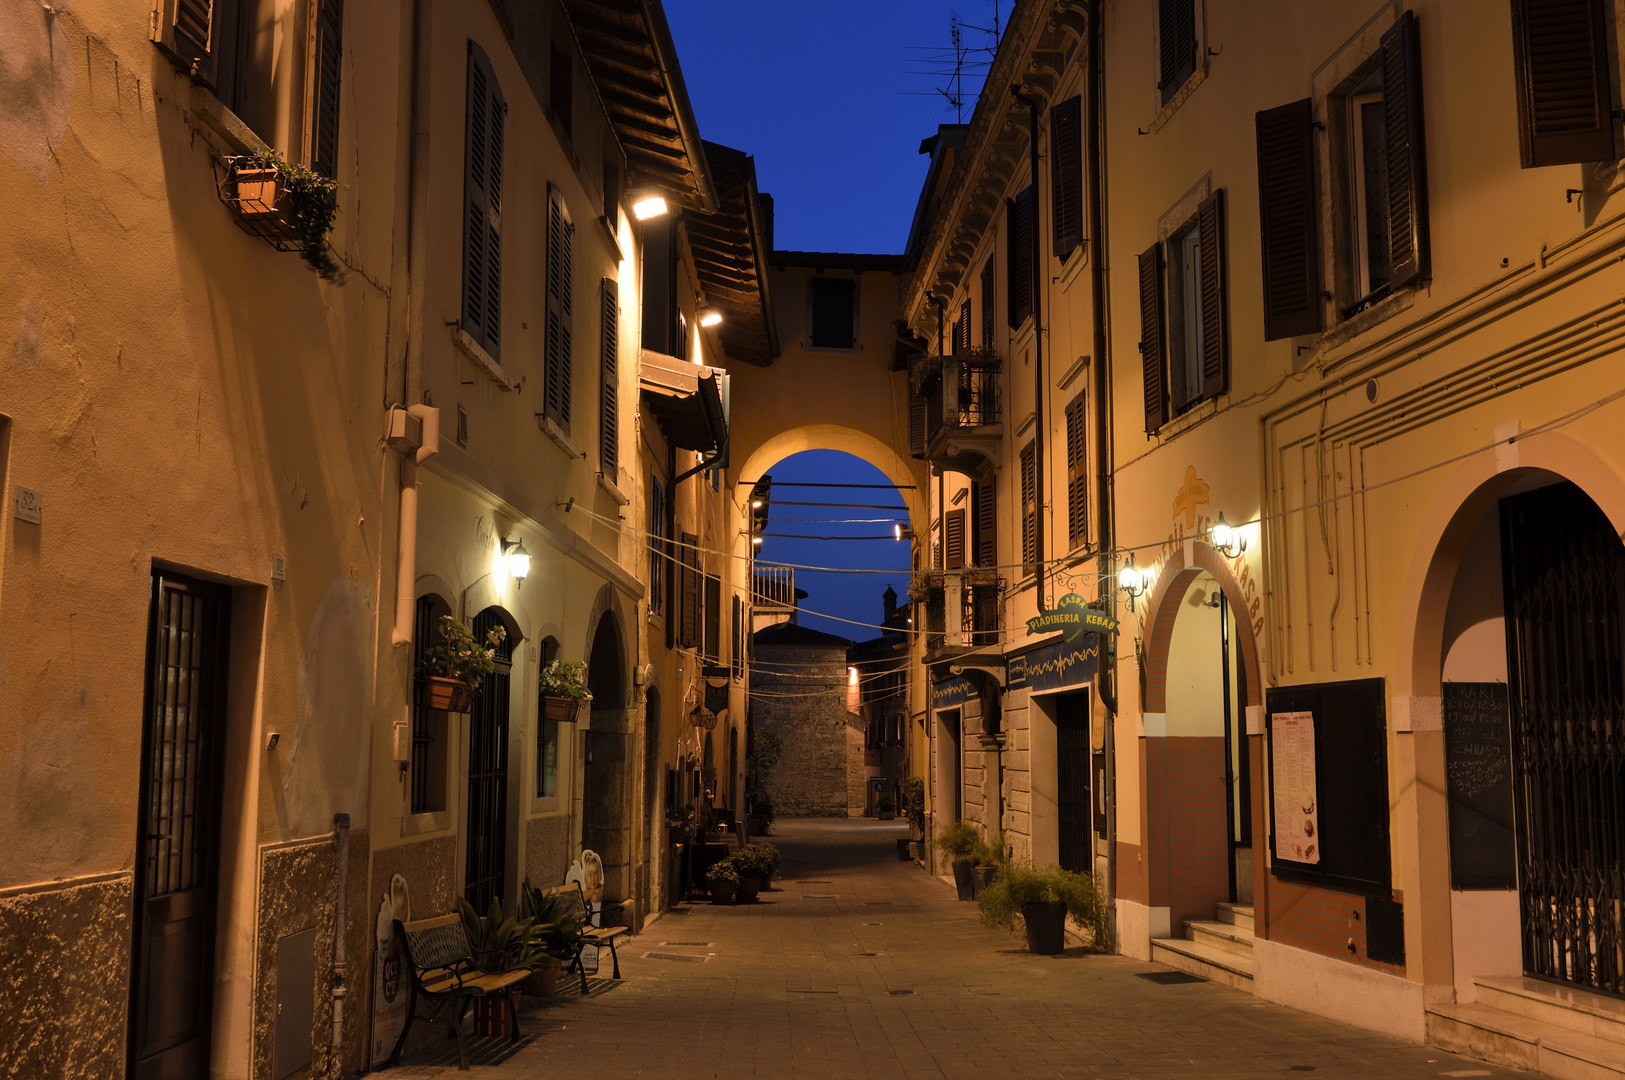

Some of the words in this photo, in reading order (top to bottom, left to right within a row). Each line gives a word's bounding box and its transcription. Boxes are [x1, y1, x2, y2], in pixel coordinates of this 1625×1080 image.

[1059, 595, 1086, 609] KASBA
[1232, 555, 1264, 638] KASBA
[1029, 613, 1080, 630] PIADINERIA
[1086, 614, 1116, 630] KEBAB
[707, 688, 727, 697] PUB
[1452, 741, 1500, 758] CHIUSO
[385, 960, 398, 980] QUI
